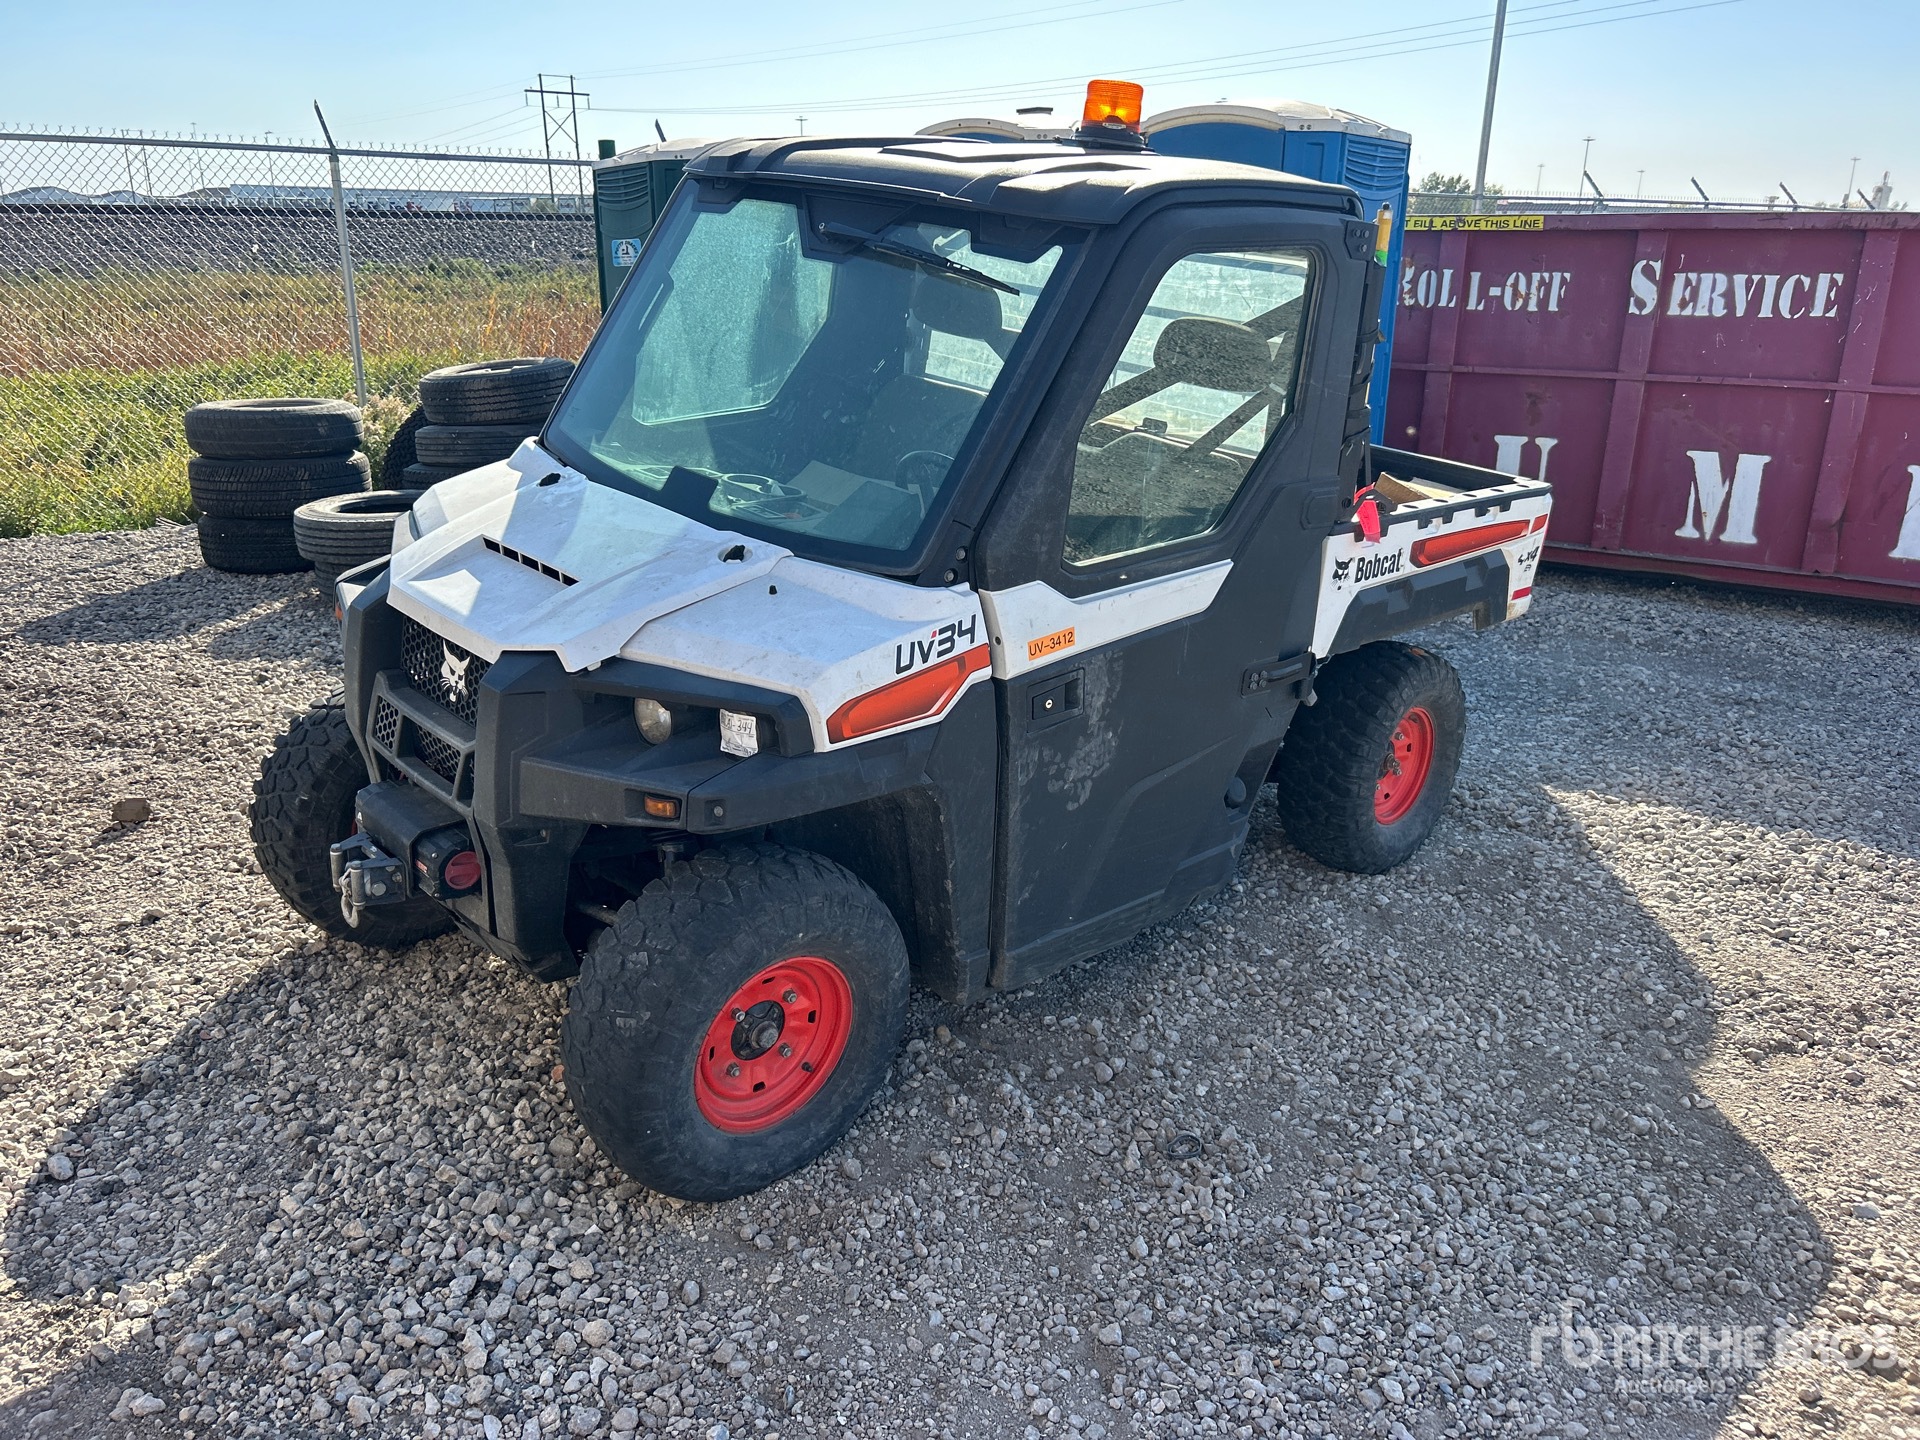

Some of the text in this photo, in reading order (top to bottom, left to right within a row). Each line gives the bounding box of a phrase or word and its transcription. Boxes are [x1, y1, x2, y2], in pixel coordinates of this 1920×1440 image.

[1440, 219, 1481, 228] ABOVE
[1484, 219, 1510, 229] THIS
[1513, 219, 1540, 228] LINE
[1628, 260, 1844, 318] SERVICE
[1354, 548, 1402, 583] Bobcat
[895, 613, 977, 675] UV34
[1029, 631, 1074, 657] UV-3412
